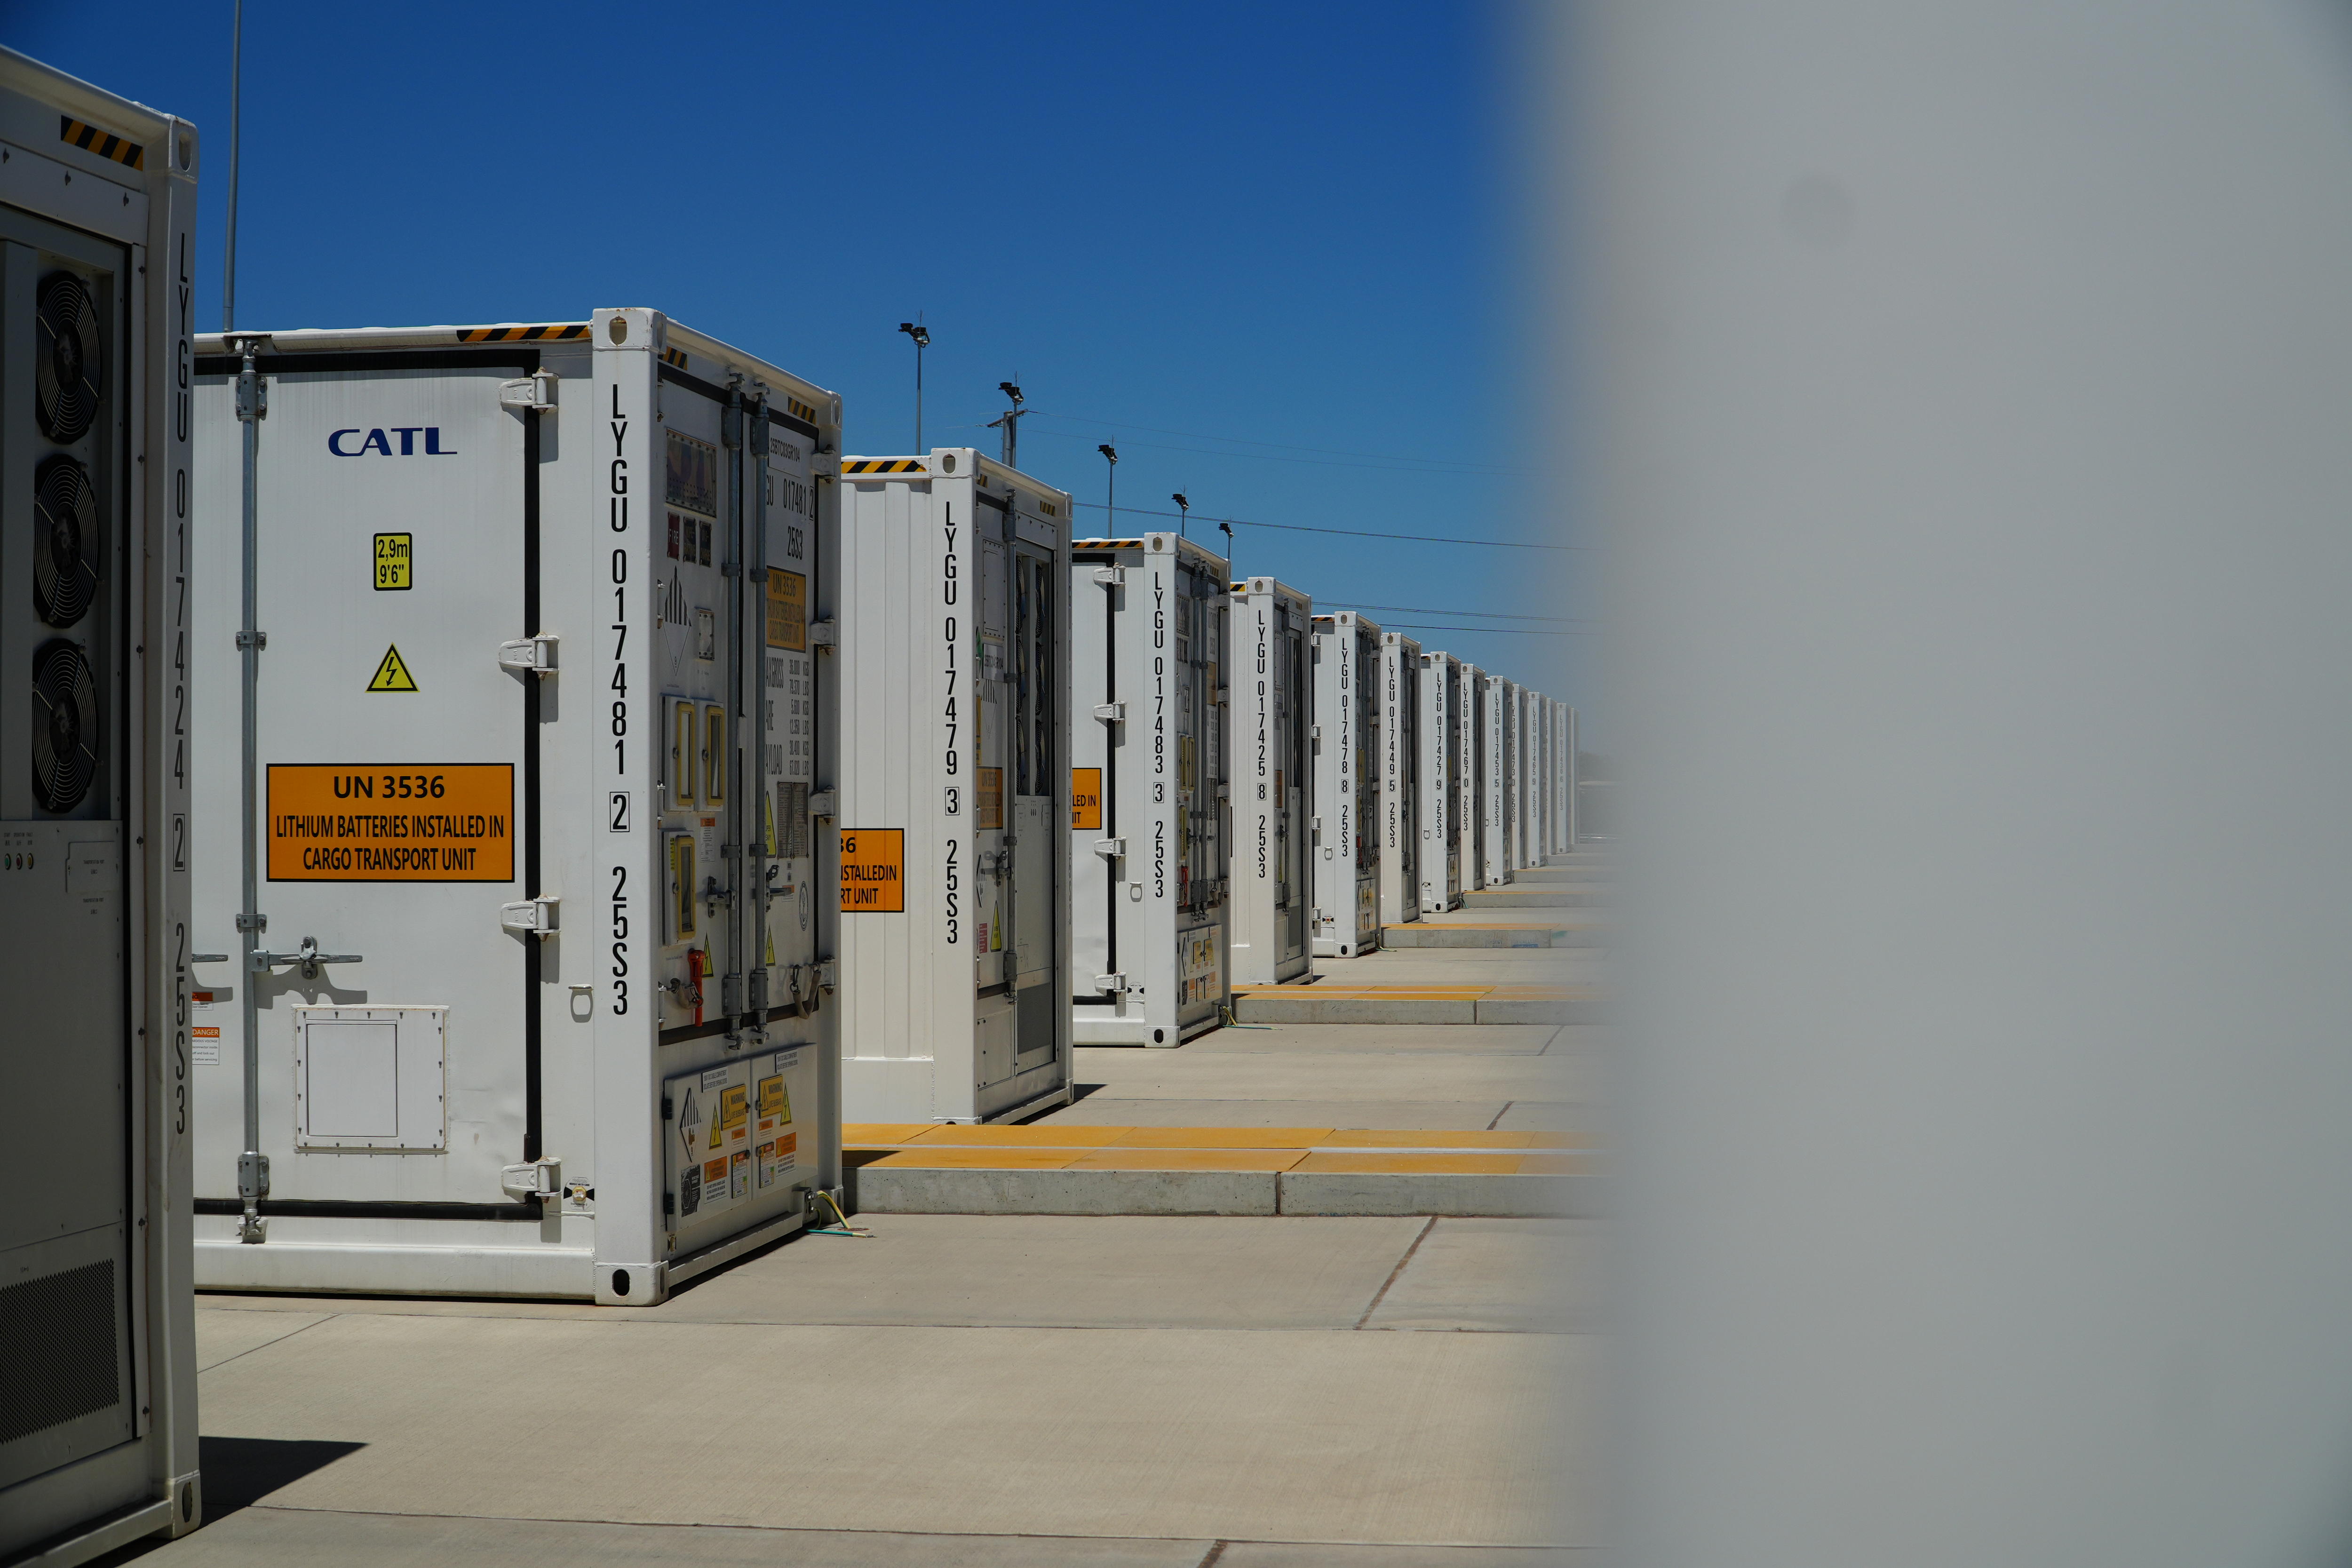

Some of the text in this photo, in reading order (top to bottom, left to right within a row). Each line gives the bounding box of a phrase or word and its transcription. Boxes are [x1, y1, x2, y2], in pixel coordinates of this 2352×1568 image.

[328, 427, 457, 456] CATL
[770, 437, 800, 463] 25BTC03GR104
[784, 478, 806, 516] 017481
[809, 488, 813, 518] 2
[669, 528, 678, 545] FIRE
[787, 525, 803, 560] 25S3
[378, 540, 408, 561] 2,9m
[773, 573, 796, 597] UN 3536
[1154, 572, 1163, 648] LYGU
[175, 233, 188, 1134] LYGU 017424 2 25S3
[766, 657, 783, 688] AXGROSS
[611, 384, 628, 1015] LYGU 017481 2 25S3
[945, 501, 958, 944] LYGU 017479 3 25S3
[766, 744, 782, 775] AYLOAD
[334, 775, 445, 798] UN 3536
[1155, 784, 1162, 802] 3
[1259, 784, 1265, 799] 8
[1342, 780, 1348, 792] 8
[1390, 780, 1395, 791] 5
[1437, 780, 1441, 790] 9
[1088, 795, 1096, 806] IN
[277, 815, 503, 837] LITHIUM BATTERIES INSTALLED IN
[1073, 812, 1081, 823] IT
[303, 847, 476, 870] CARGO TRANSPORT UNIT
[854, 888, 878, 904] UNIT
